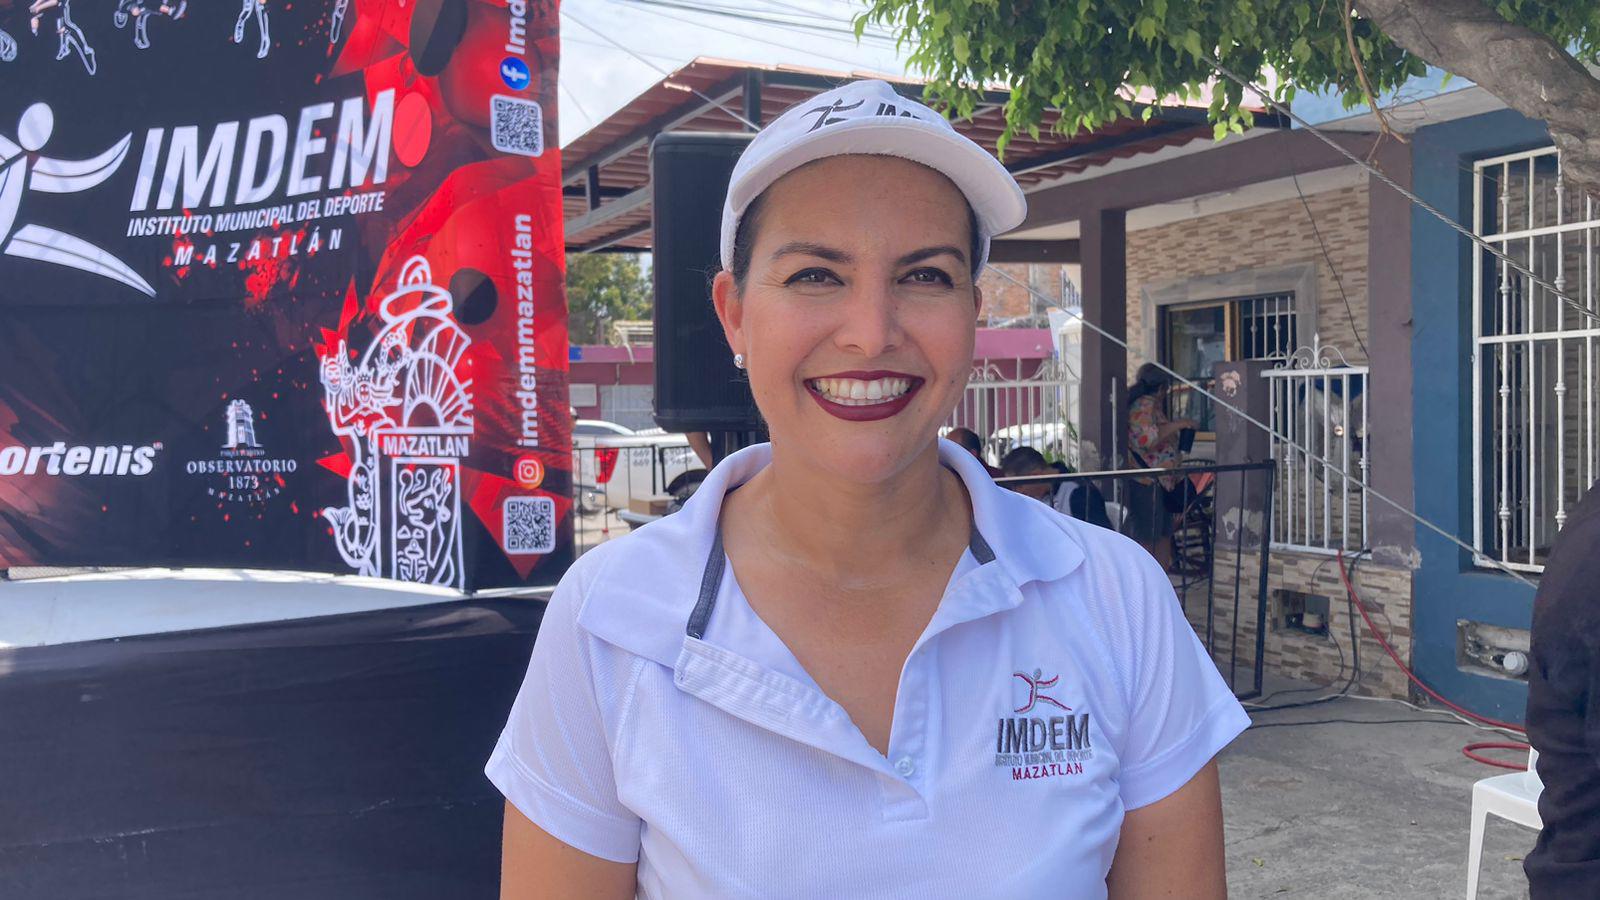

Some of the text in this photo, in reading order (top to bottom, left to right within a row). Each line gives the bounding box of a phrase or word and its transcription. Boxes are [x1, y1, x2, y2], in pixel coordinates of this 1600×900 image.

[130, 88, 395, 212] IMDEM
[126, 190, 386, 238] INSTITUTO MUNICIPAL DEL DEPORTE
[173, 225, 342, 267] MAZATLÁN
[511, 213, 536, 447] imdemmazatlan
[383, 435, 470, 457] MAZATLAN
[186, 459, 297, 474] OBSERVATORIO
[229, 475, 259, 489] 1873
[998, 714, 1092, 753] IMDEM
[1012, 762, 1083, 781] MAZATLAN
